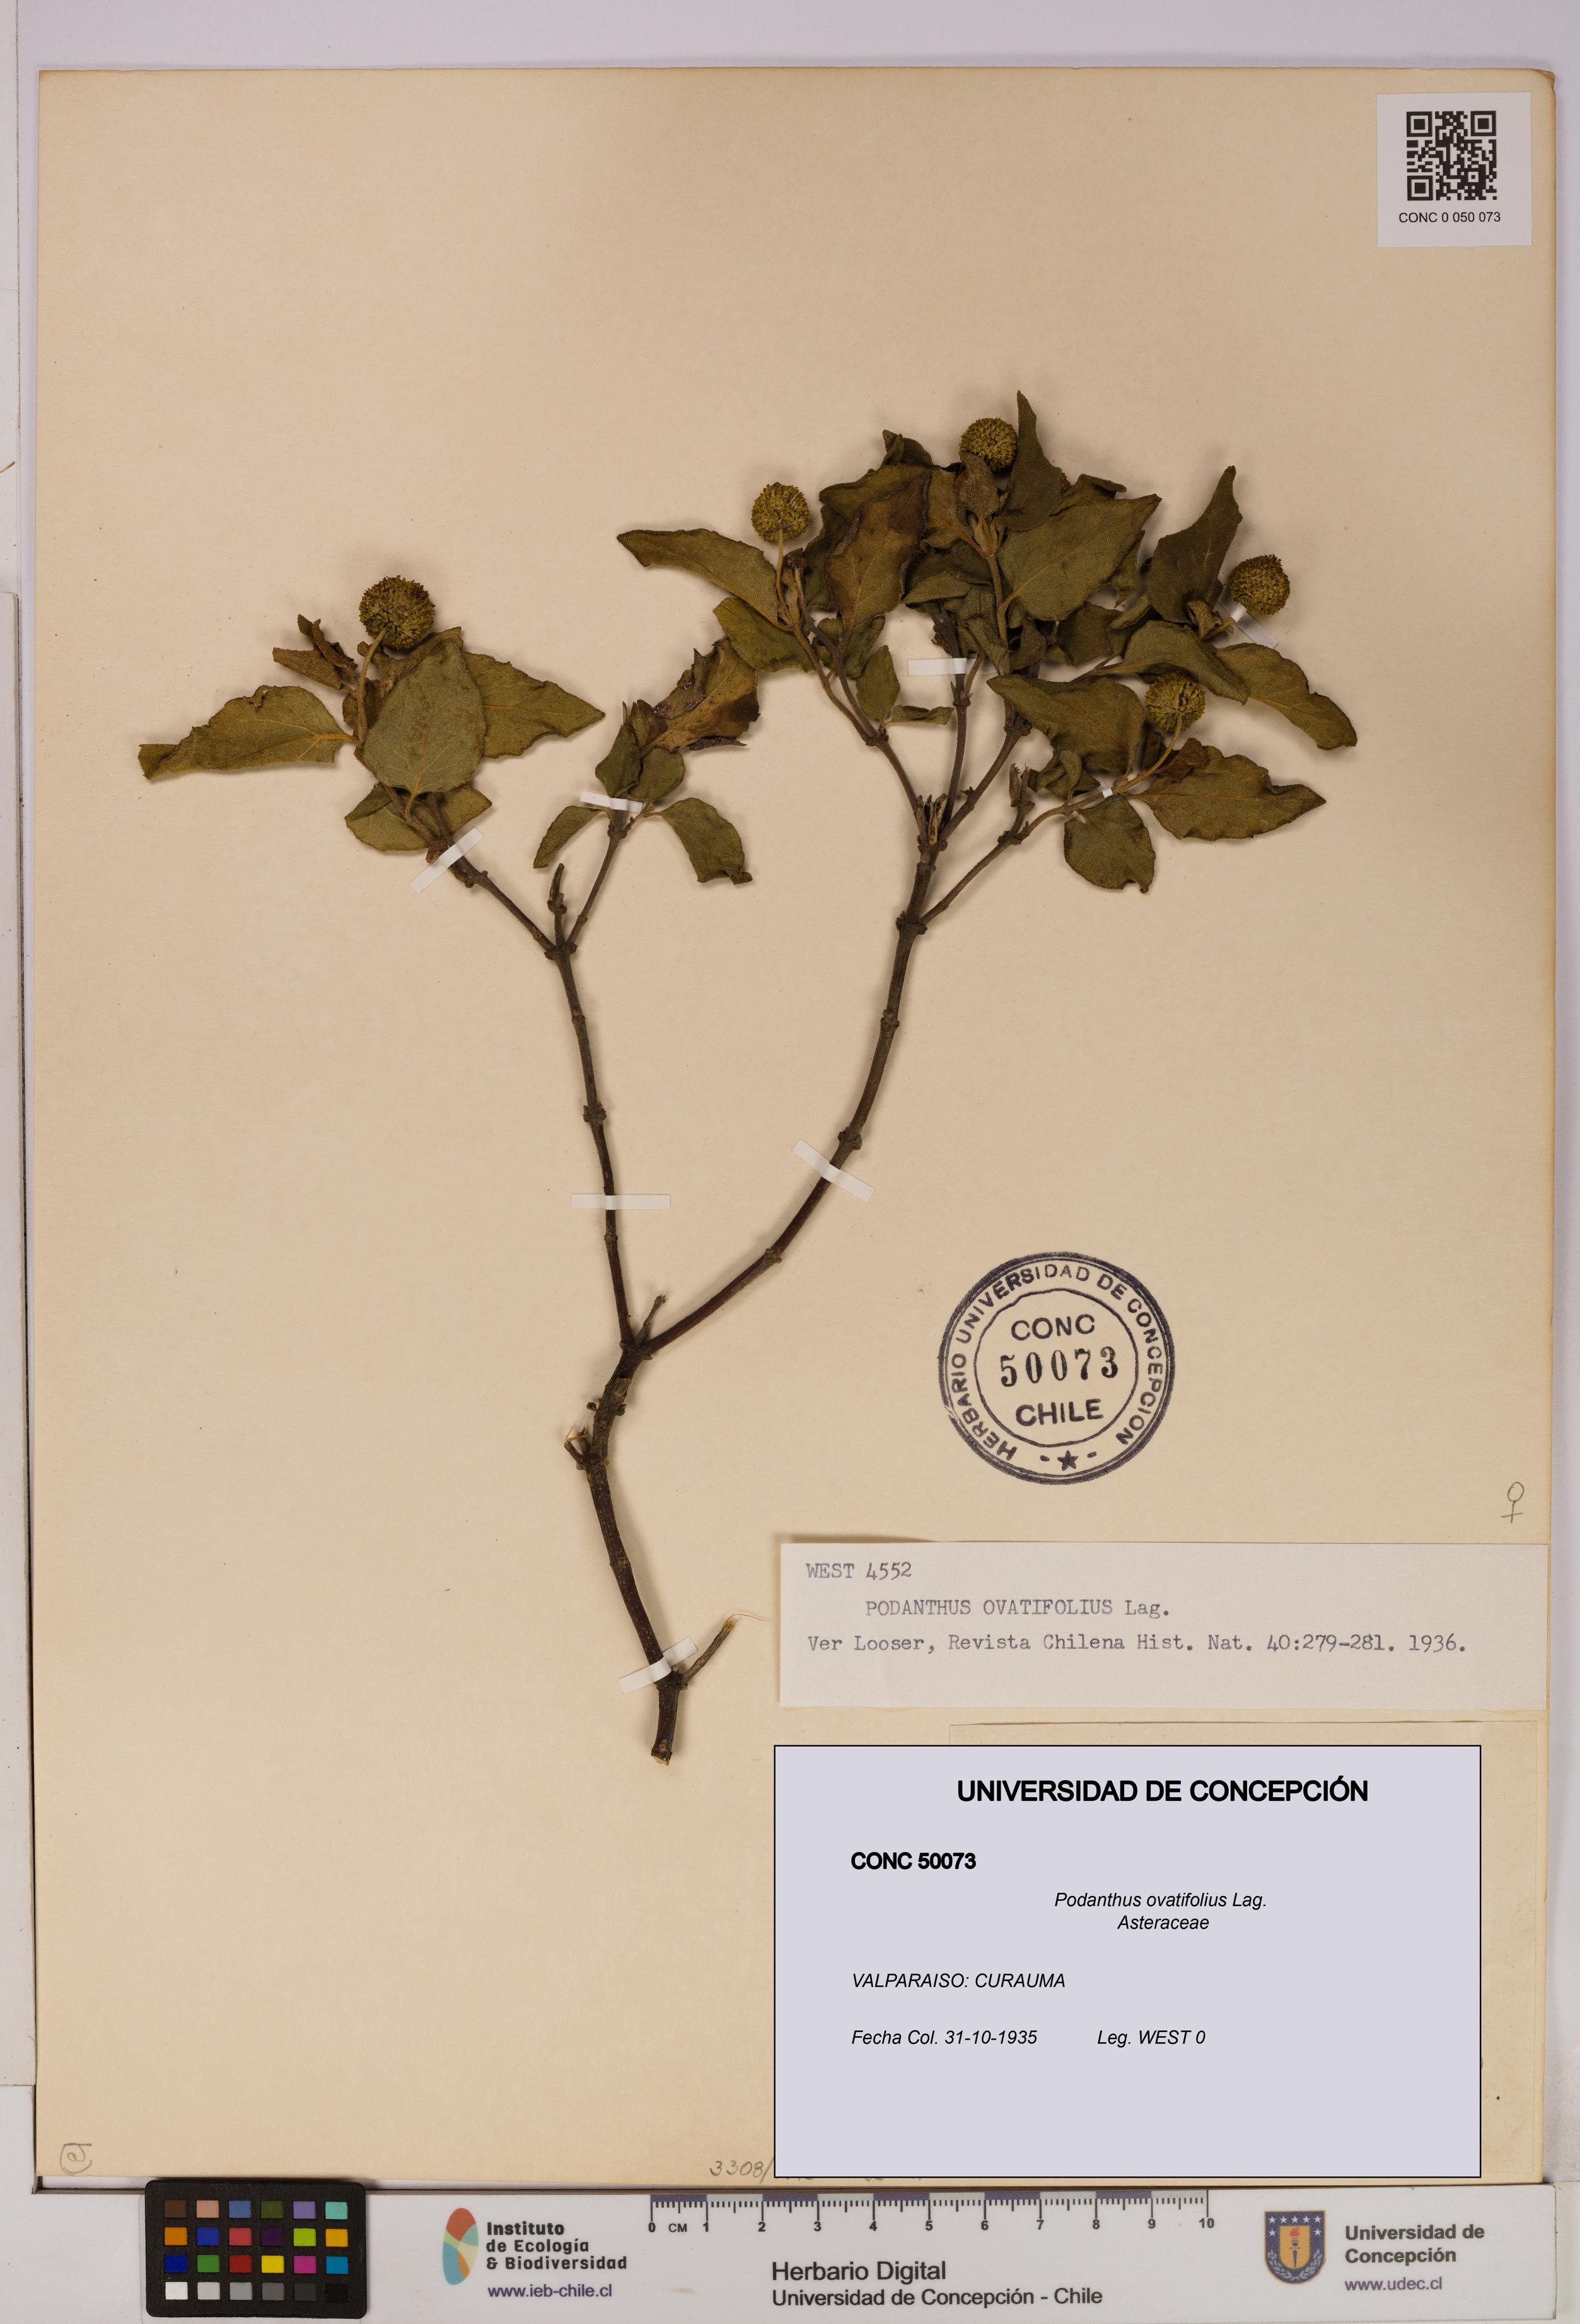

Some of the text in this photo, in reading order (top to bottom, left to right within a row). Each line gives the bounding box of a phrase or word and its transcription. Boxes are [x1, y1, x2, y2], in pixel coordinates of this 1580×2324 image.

[1398, 211, 1501, 223] CONC 0 050 073
[1011, 1314, 1095, 1341] CONC
[951, 1263, 1163, 1460] HERBARIO UNIVERSIDAD DE CONCEPCION
[1000, 1346, 1118, 1387] 50073
[1015, 1398, 1104, 1427] CHILE
[805, 1561, 912, 1581] WEST 4552
[866, 1598, 1169, 1619] PODANTHUS OVATIFOLIUS Lag.
[807, 1633, 1466, 1655] Ver Looser, Revista Chilena Hist. Nat. 40:279-281. 1936.
[487, 2221, 565, 2236] Instituto
[648, 2217, 1215, 2233] 0 CM 1 2 3 4 5 6 7 8 9 10
[1345, 2223, 1485, 2241] Universidad de
[485, 2238, 589, 2255] de Ecología
[486, 2255, 627, 2270] & Biodiversidad
[1344, 2247, 1456, 2267] Concepción
[772, 2260, 946, 2286] Herbario Digital
[1344, 2275, 1443, 2291] www.udec.cl
[487, 2283, 612, 2298] www.ieb-chile.cl
[772, 2289, 885, 2306] Universidad
[891, 2289, 915, 2306] de
[921, 2288, 1035, 2309] Concepción
[1054, 2287, 1103, 2304] Chile
